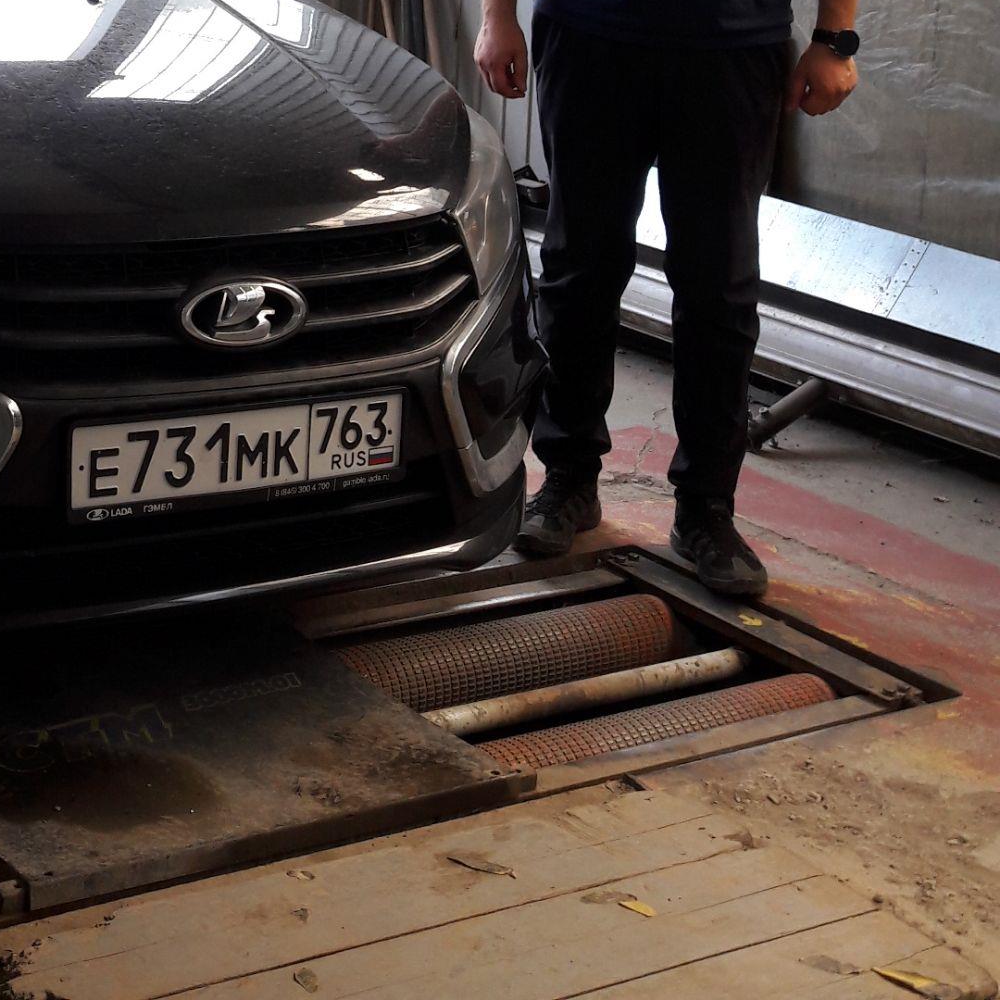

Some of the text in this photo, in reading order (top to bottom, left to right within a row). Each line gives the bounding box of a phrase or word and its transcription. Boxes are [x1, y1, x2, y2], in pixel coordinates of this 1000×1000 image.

[89, 401, 389, 498] Е731МК 763
[331, 451, 367, 470] RUS
[110, 507, 133, 517] LADA
